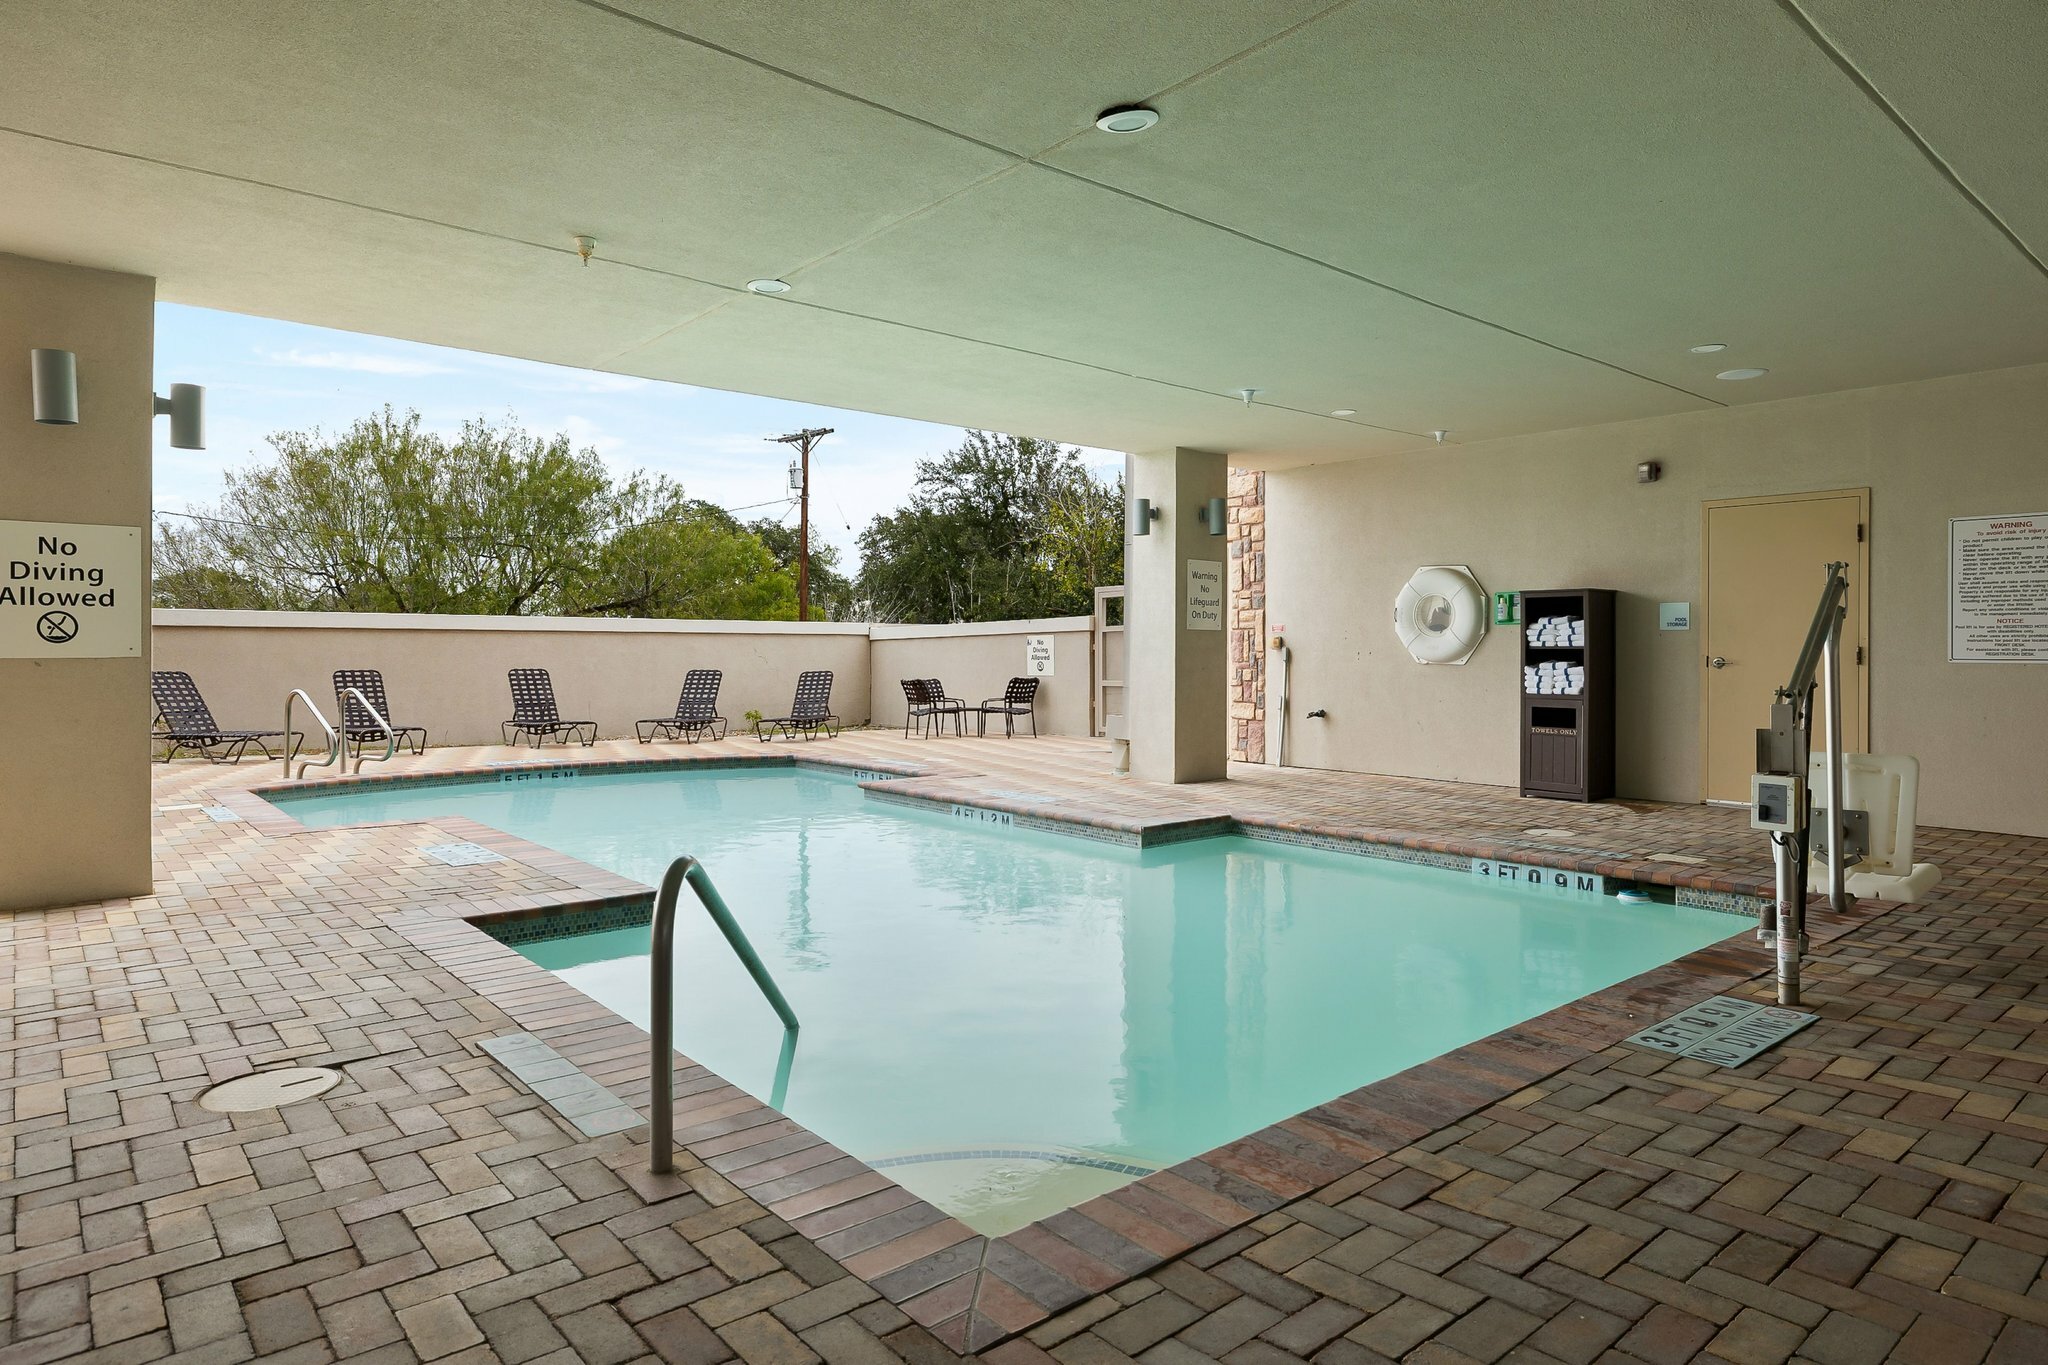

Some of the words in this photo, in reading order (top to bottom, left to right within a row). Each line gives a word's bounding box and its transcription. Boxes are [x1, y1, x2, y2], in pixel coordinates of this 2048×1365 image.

[1990, 521, 2032, 529] WARNING
[39, 537, 77, 555] No
[10, 561, 103, 586] Diving
[1192, 571, 1217, 582] Warning
[1201, 585, 1210, 593] No
[0, 586, 114, 606] Allowed
[1190, 597, 1219, 608] Lifeguard
[1203, 611, 1217, 621] Duty
[1688, 1047, 1740, 1066] NO
[1716, 1018, 1793, 1049] DIVING
